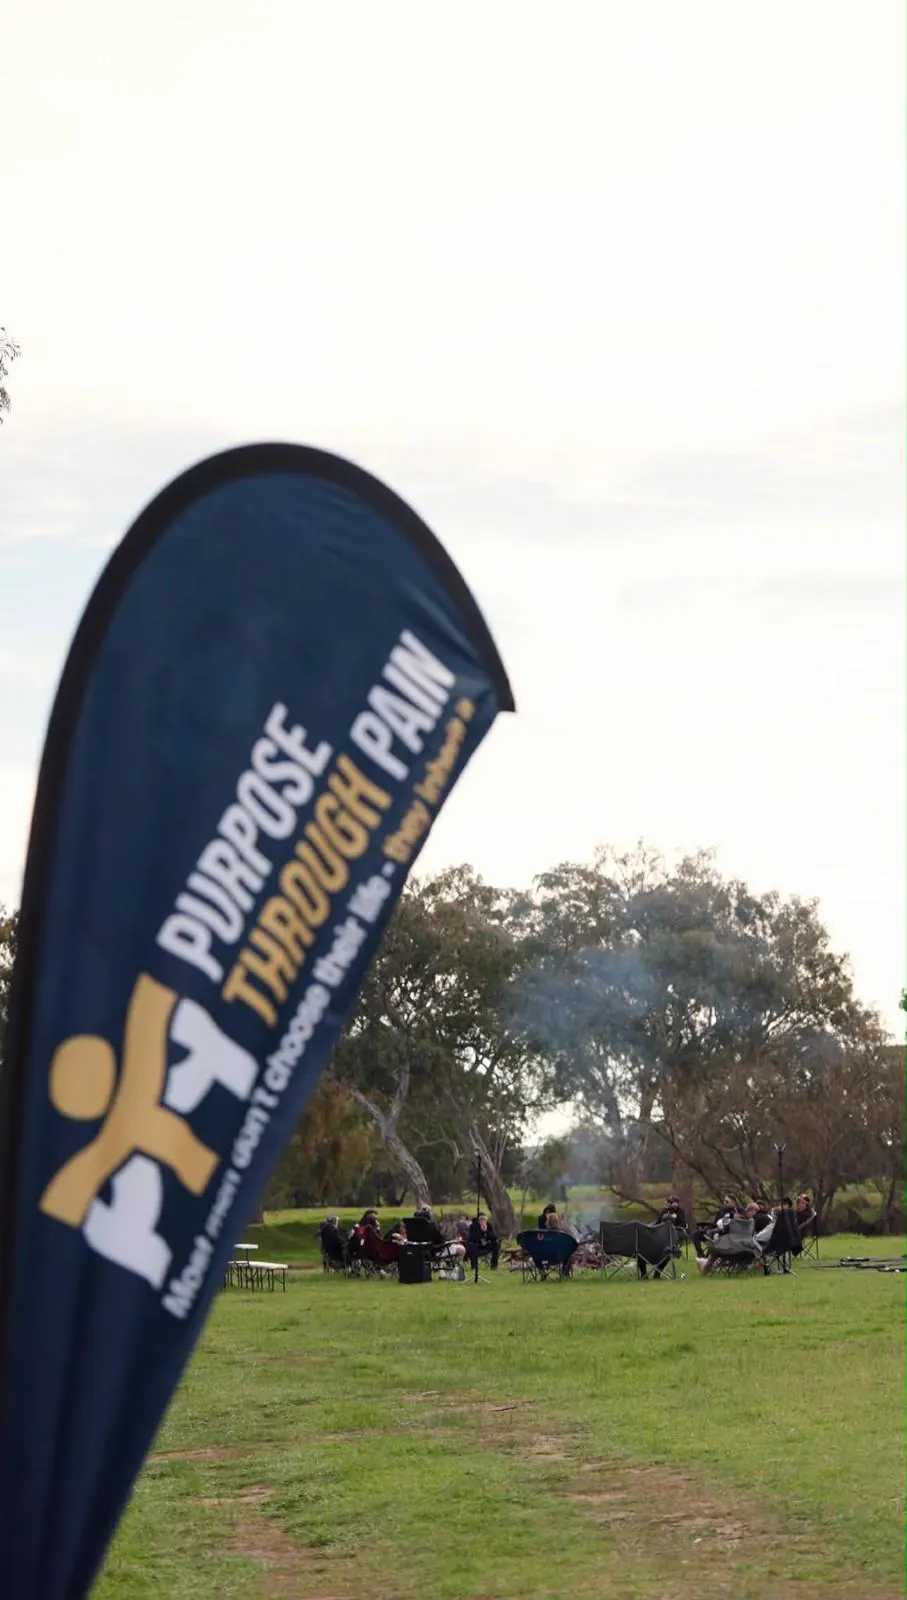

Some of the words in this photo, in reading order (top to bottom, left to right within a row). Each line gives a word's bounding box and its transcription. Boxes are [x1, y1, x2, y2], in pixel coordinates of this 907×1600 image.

[156, 702, 333, 984] PURPOSE
[222, 753, 393, 1029] THROUGH
[350, 628, 456, 781] PAIN
[161, 1235, 214, 1319] Most
[231, 1086, 280, 1169] don't
[263, 983, 331, 1092] choose
[312, 915, 368, 988] their
[346, 874, 392, 924] life
